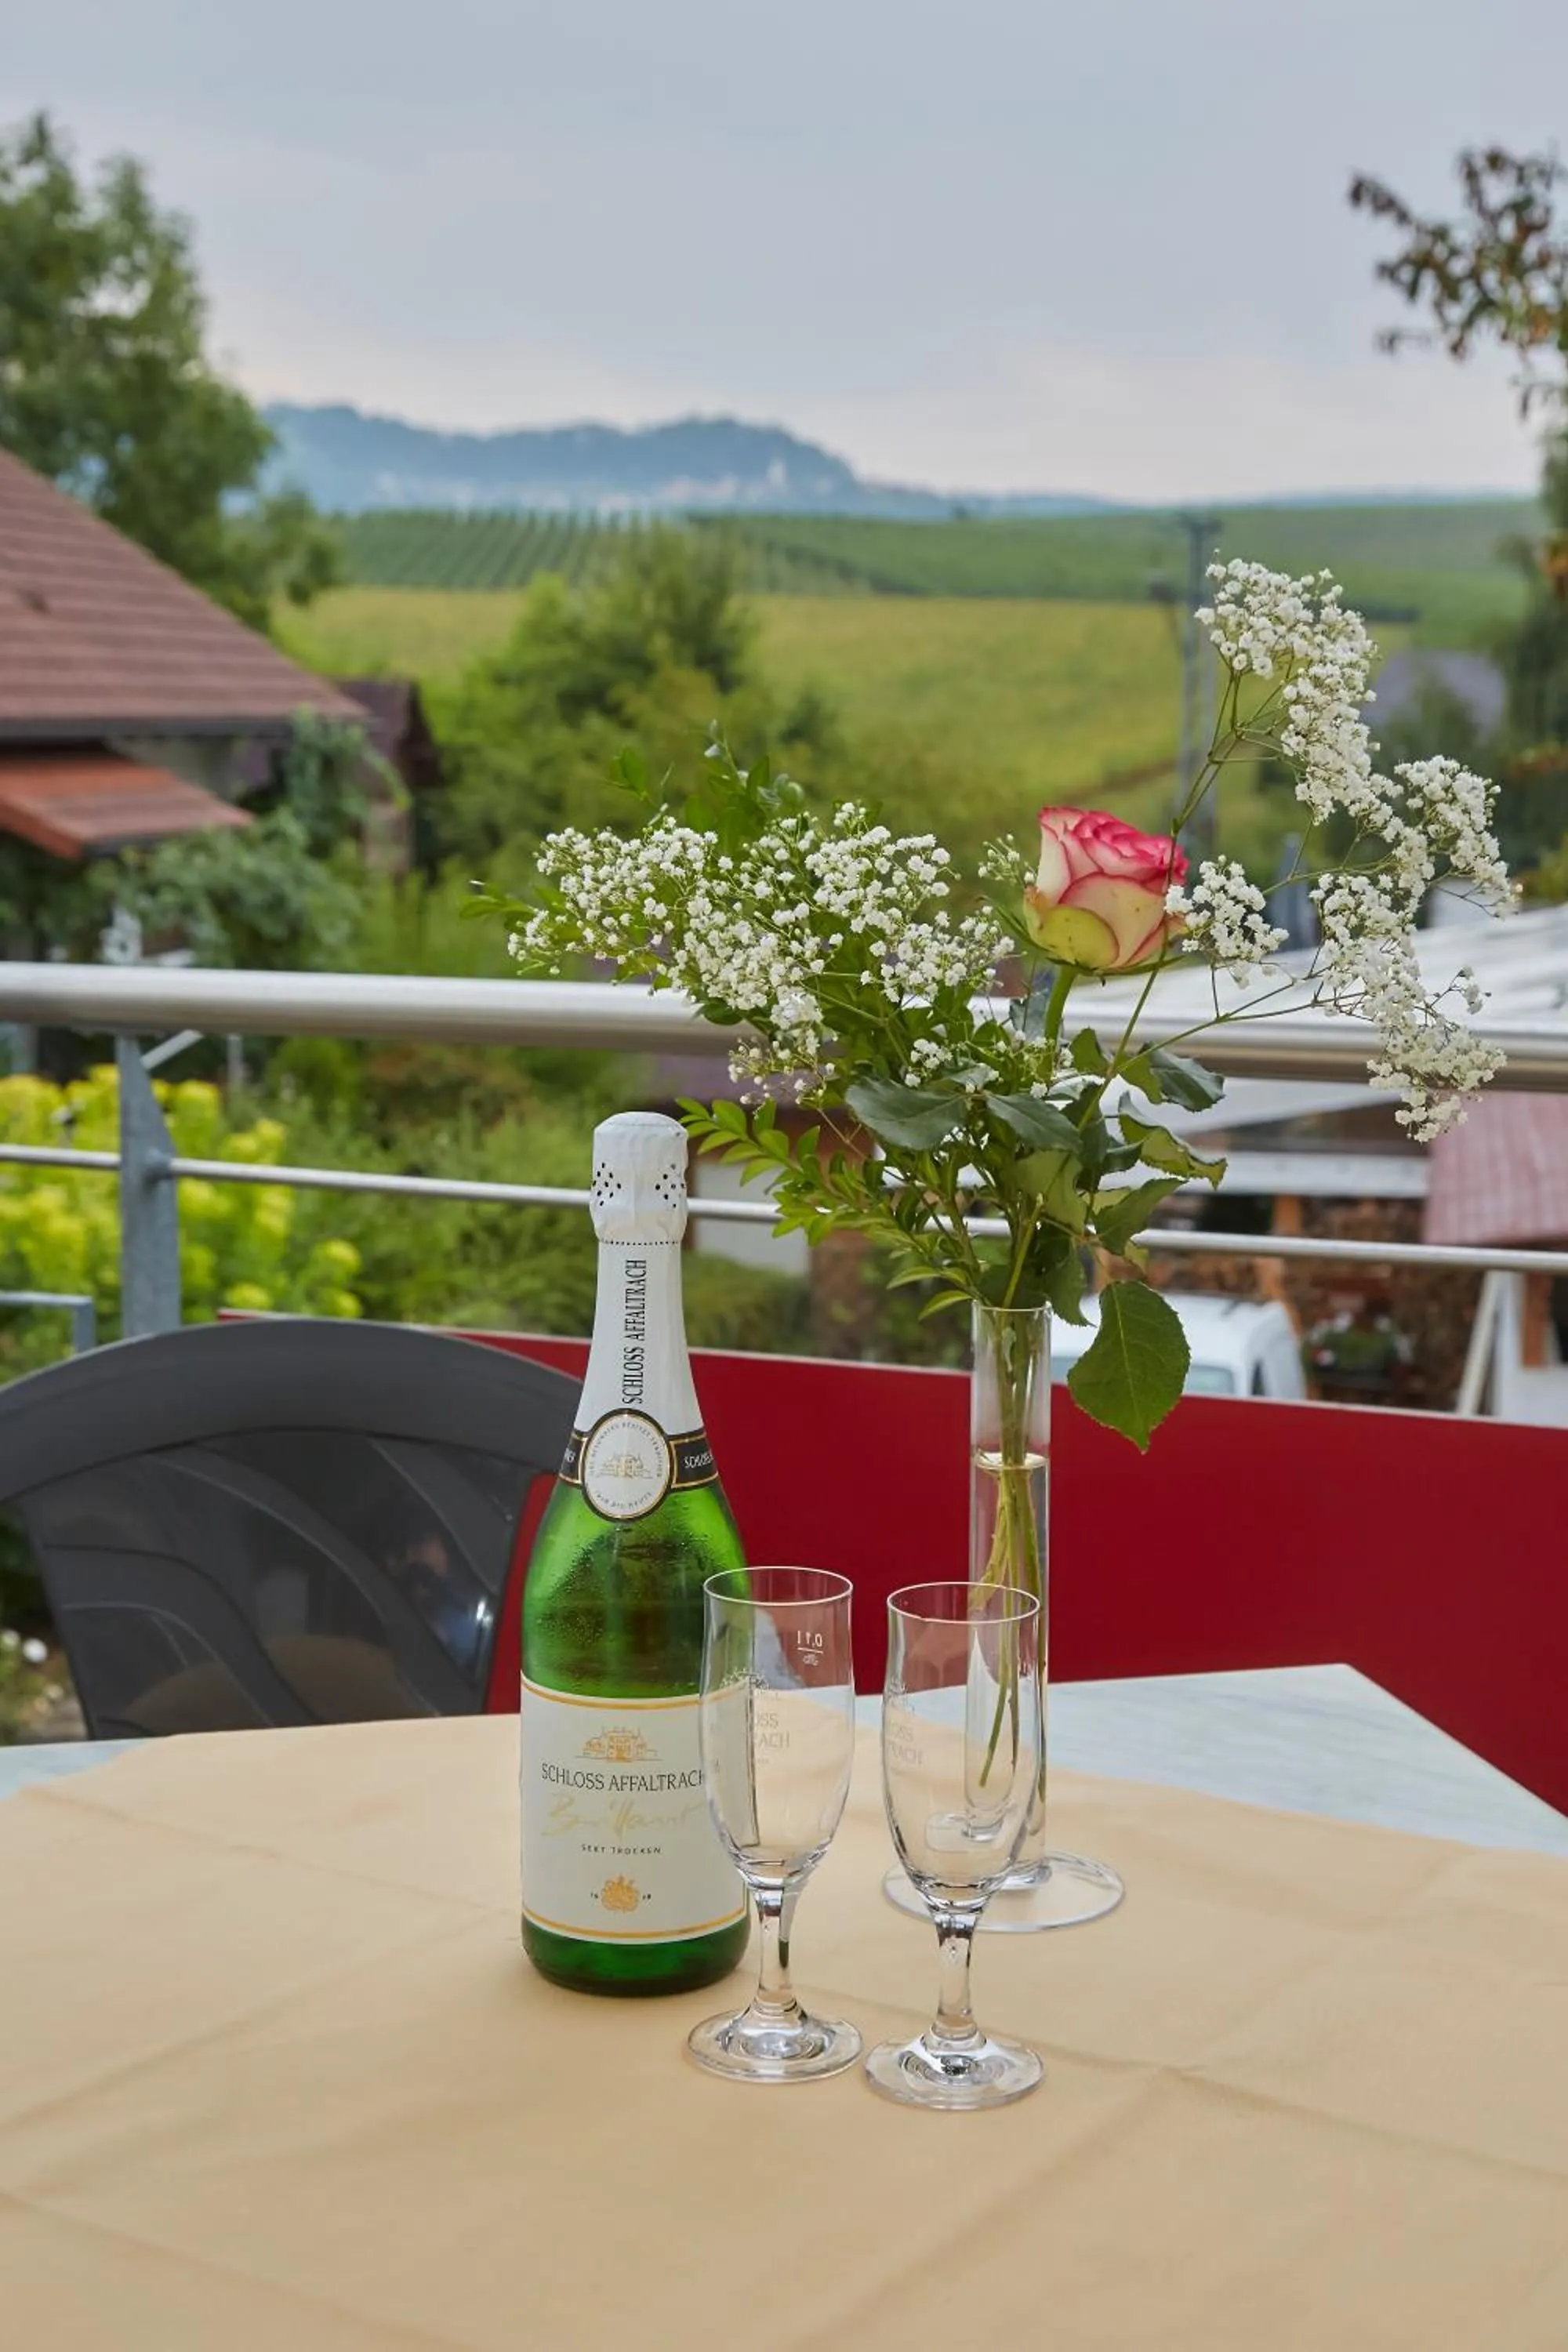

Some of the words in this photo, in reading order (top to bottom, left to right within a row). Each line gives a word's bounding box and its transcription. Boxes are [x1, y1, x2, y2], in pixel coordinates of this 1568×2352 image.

[624, 1259, 647, 1341] AFFALTRACH
[622, 1346, 644, 1404] SCHLOSS
[541, 1762, 604, 1791] SCHLOSS
